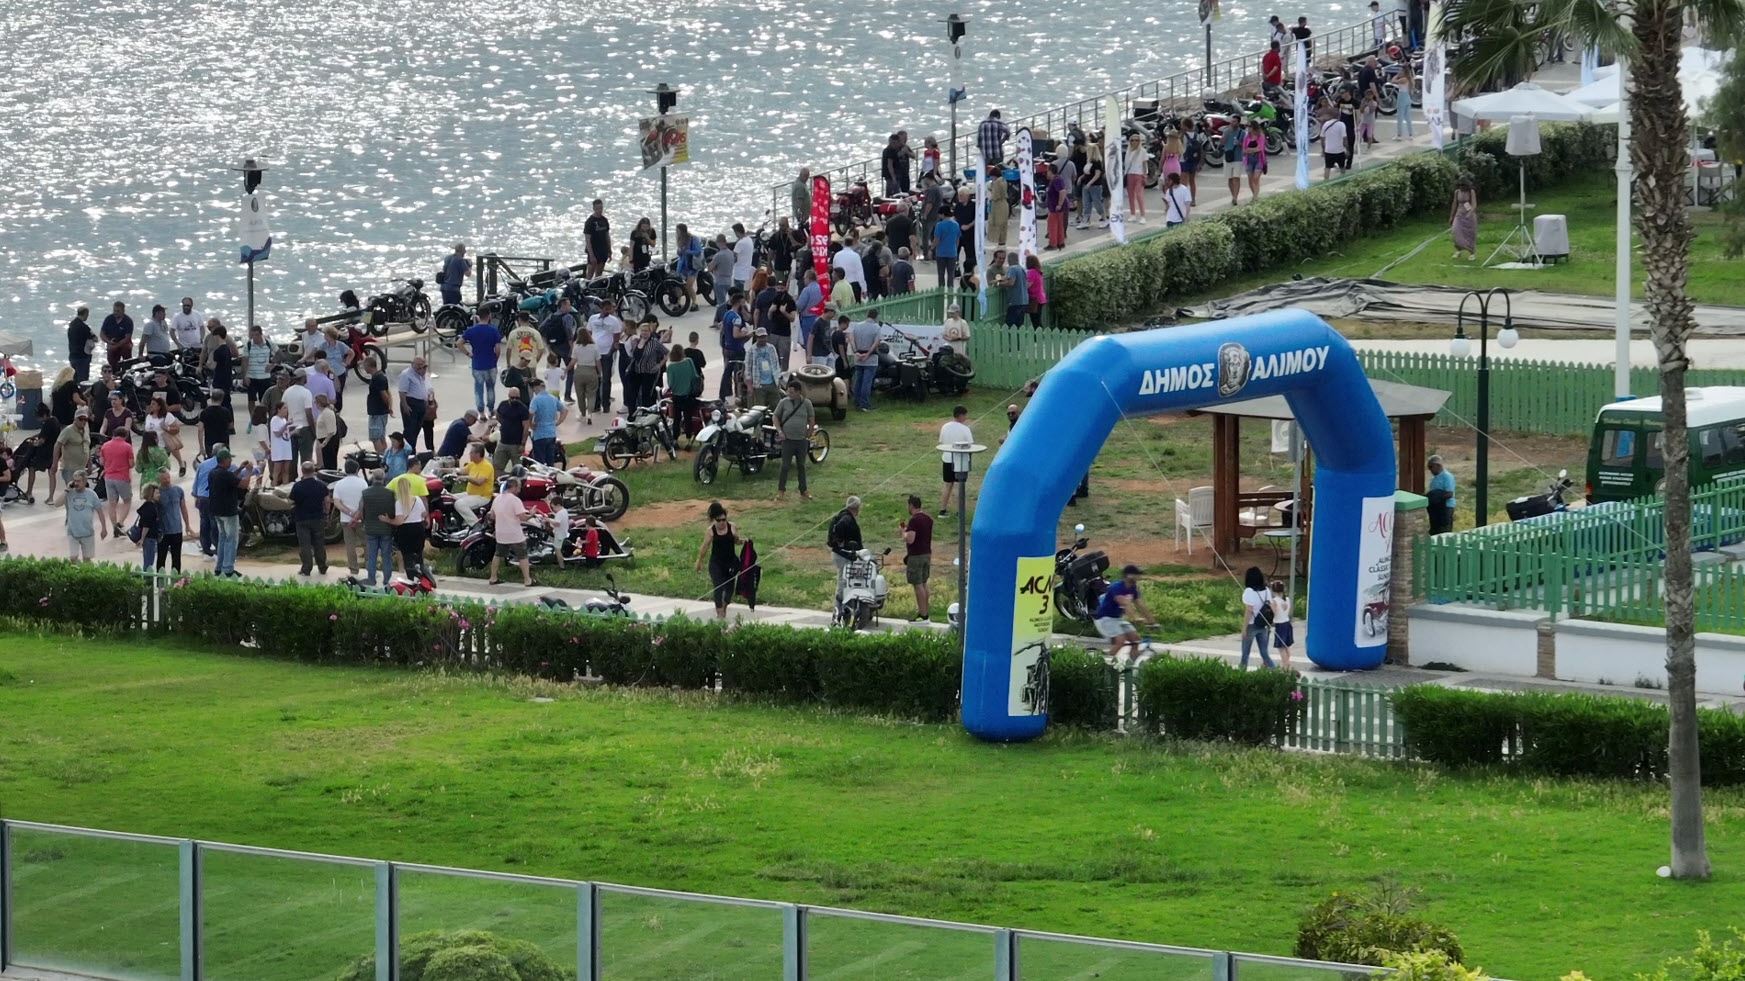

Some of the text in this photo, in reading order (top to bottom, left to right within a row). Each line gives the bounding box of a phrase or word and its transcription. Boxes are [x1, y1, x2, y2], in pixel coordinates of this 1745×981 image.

[1138, 345, 1330, 395] ΔΗΜΟΣ ΑΛΙΜΟΥ
[1039, 595, 1049, 614] 3
